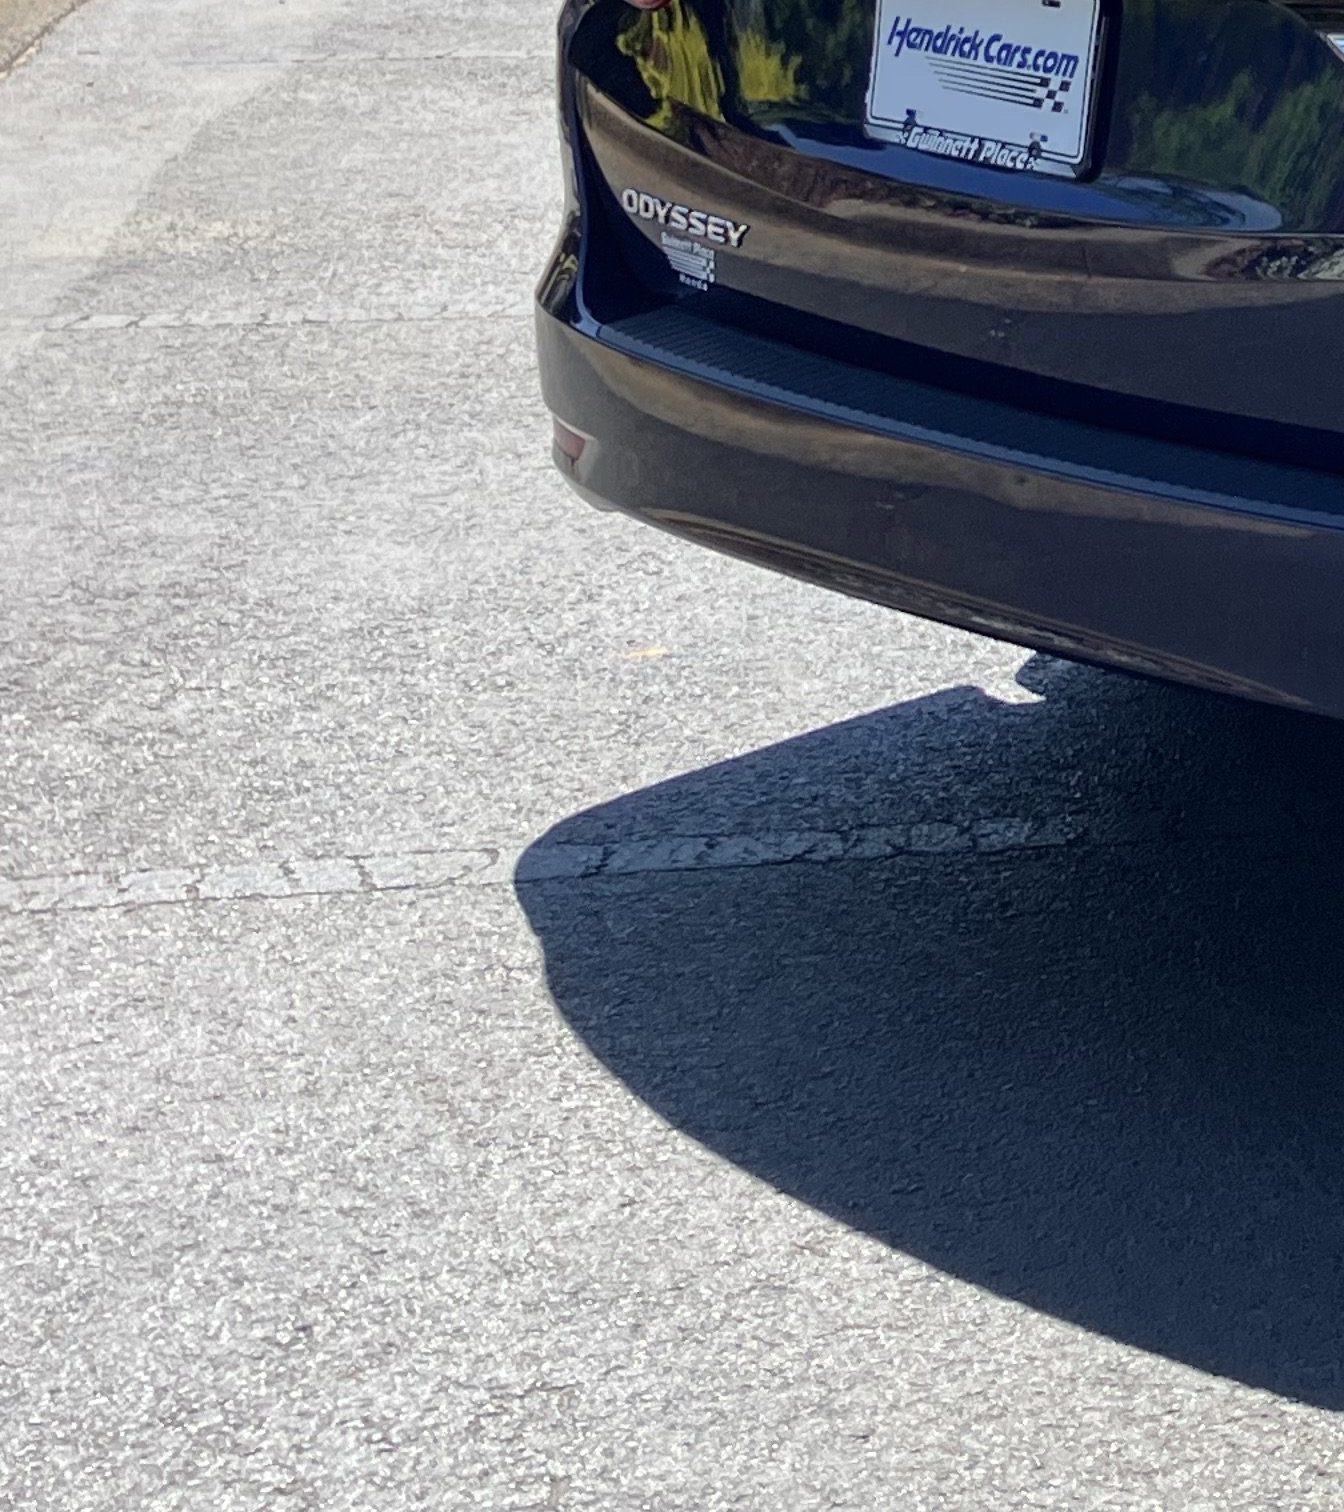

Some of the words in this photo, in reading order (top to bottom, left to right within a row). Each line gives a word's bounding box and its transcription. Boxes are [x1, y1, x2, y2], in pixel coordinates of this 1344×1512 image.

[887, 16, 1079, 79] HendrickCars.com
[978, 139, 1029, 170] Place
[622, 188, 748, 248] ODYSSEY
